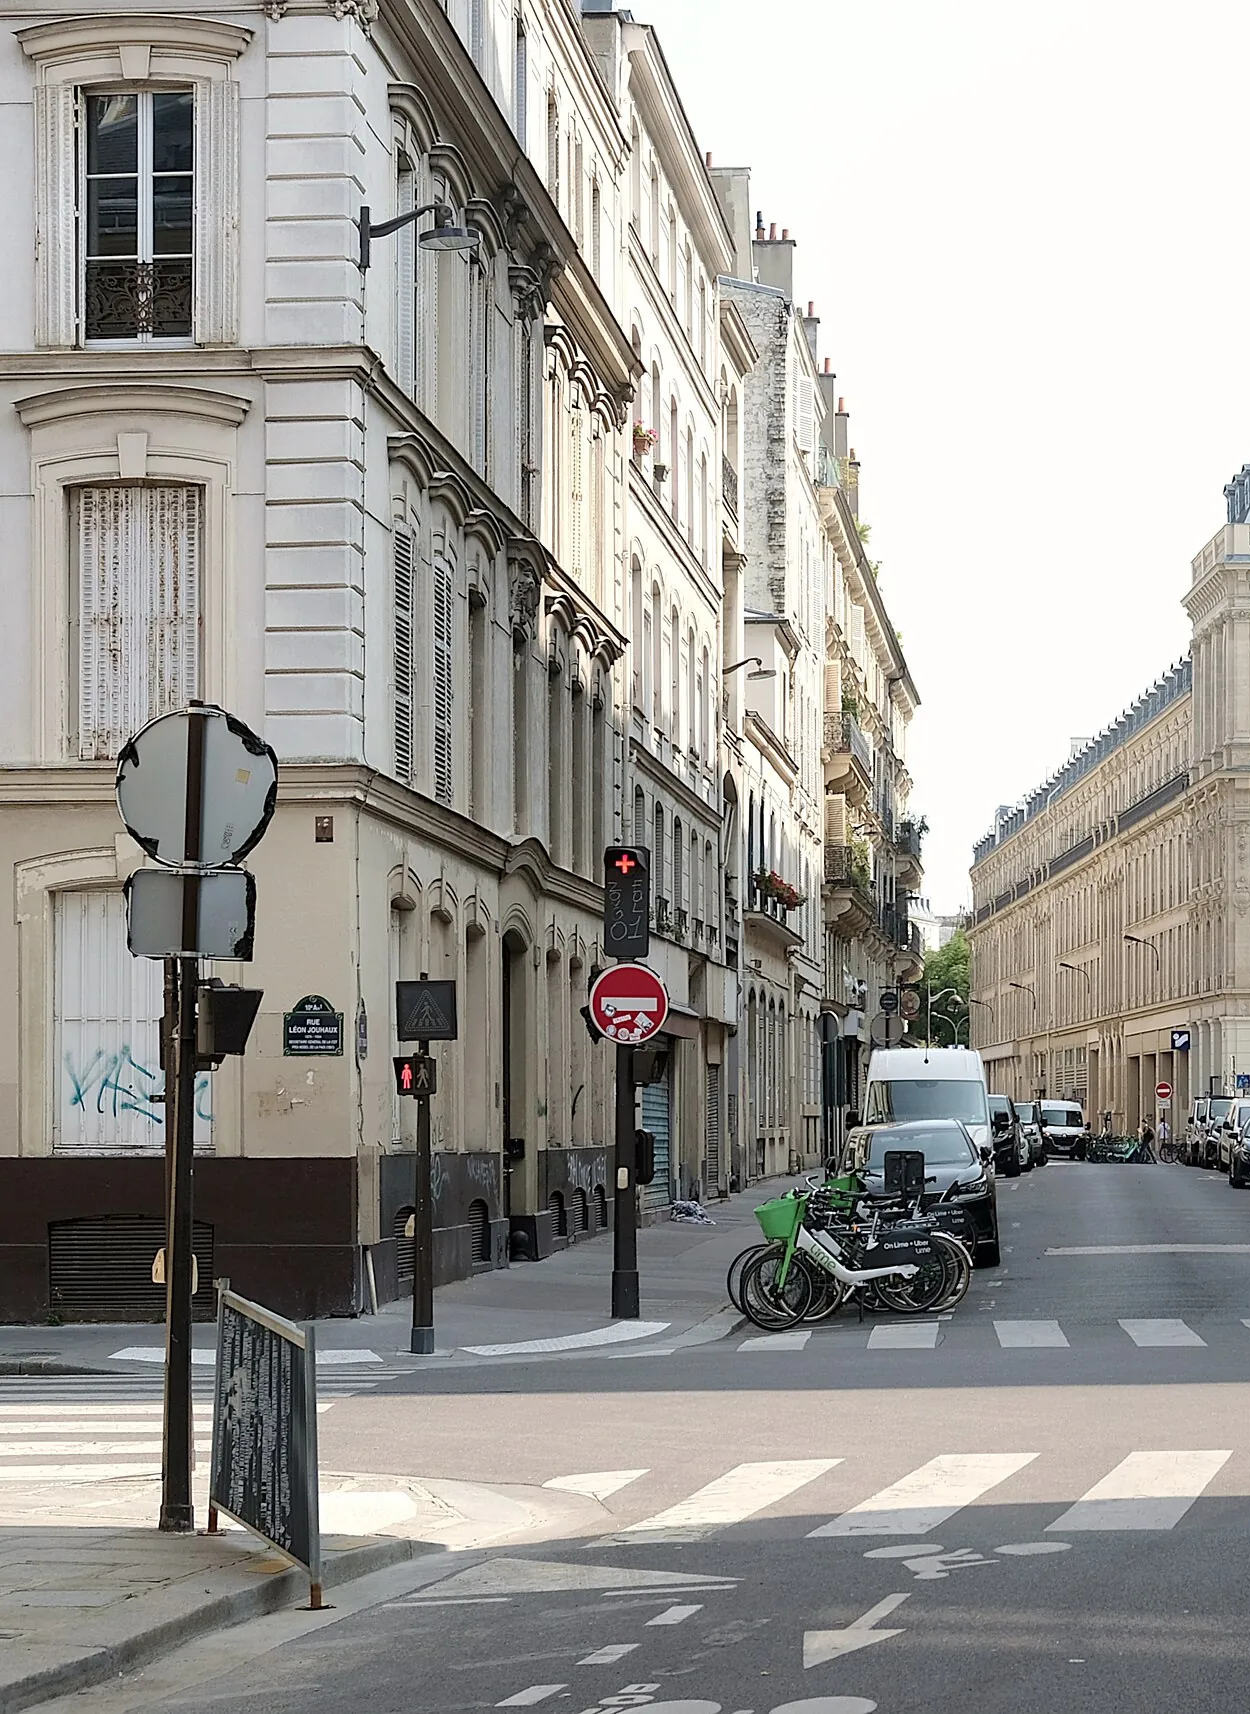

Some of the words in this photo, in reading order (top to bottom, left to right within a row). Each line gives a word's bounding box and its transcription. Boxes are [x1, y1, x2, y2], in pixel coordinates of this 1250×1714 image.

[288, 1025, 307, 1034] LÉON
[307, 1026, 338, 1034] JOUHAUX
[883, 1242, 894, 1250] On
[893, 1241, 909, 1249] Lime
[915, 1246, 931, 1255] Lime
